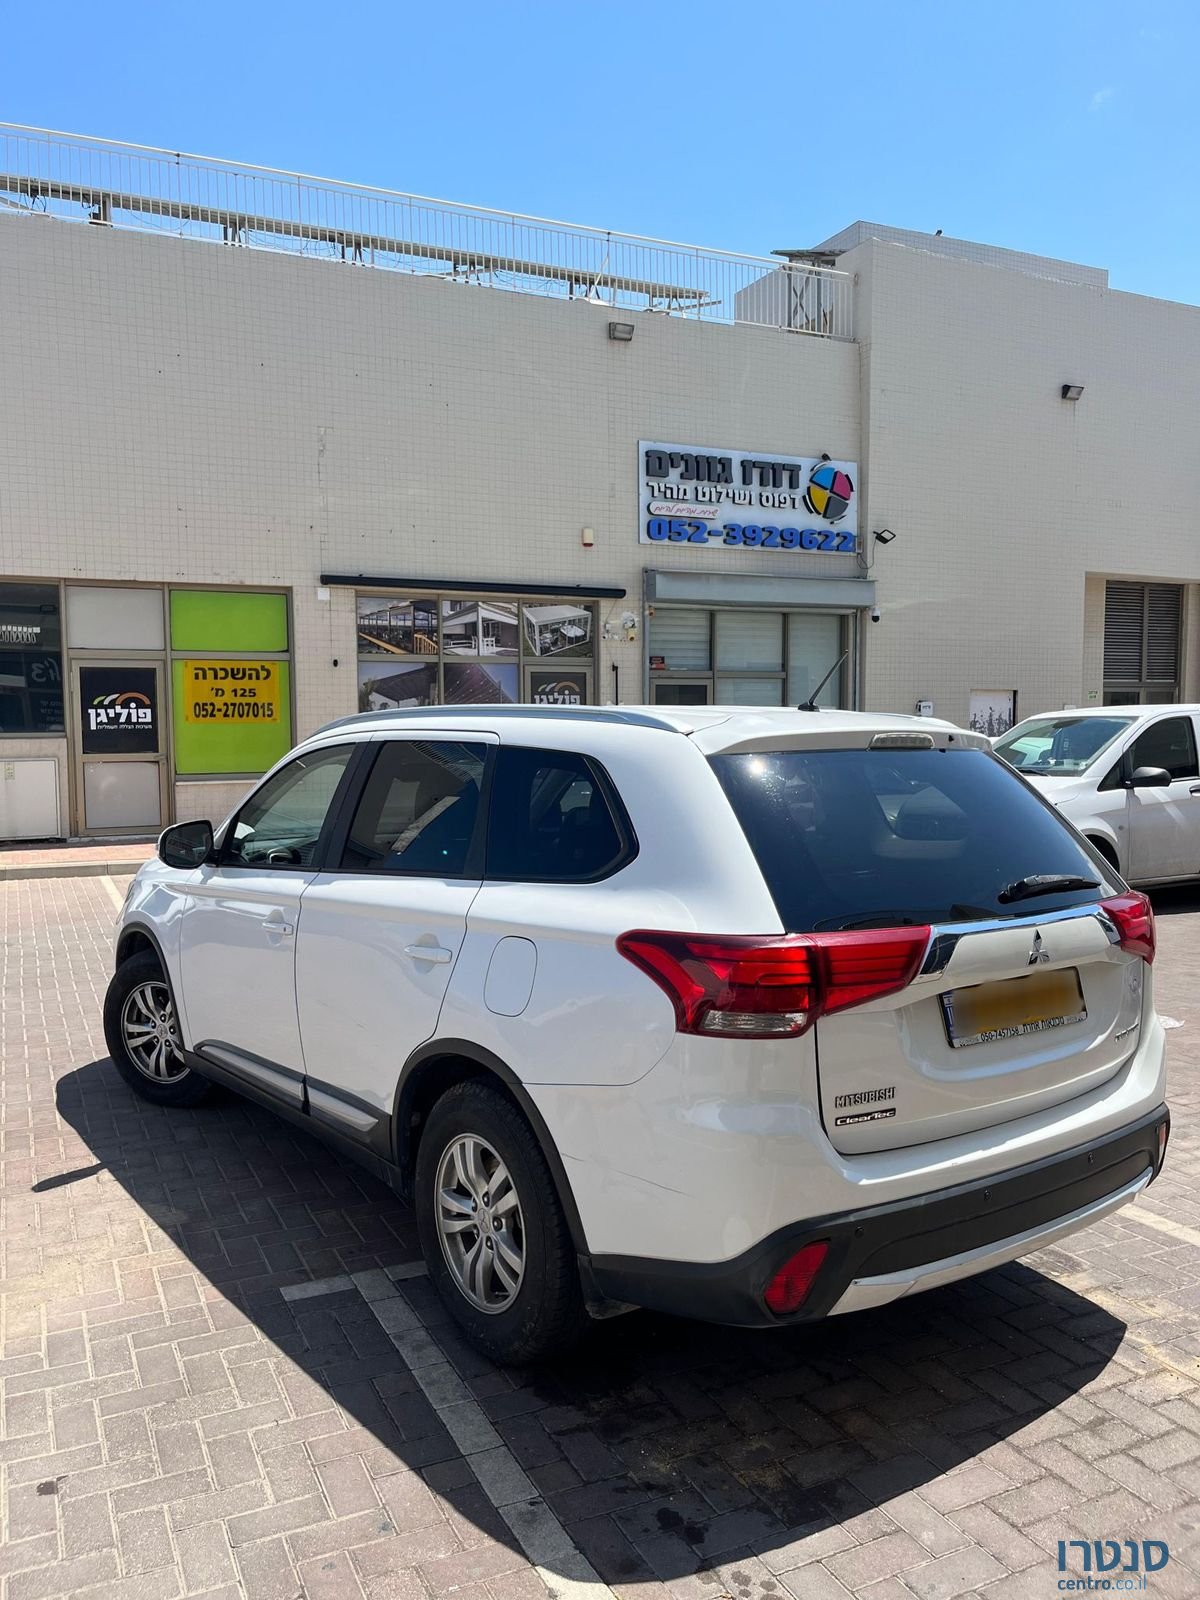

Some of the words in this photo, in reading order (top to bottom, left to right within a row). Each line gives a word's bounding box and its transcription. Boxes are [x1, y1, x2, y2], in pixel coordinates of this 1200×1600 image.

[645, 450, 733, 484] גוונים
[741, 459, 801, 489] דודו
[647, 481, 691, 500] מהיר
[695, 485, 754, 506] ושילוט
[759, 491, 800, 509] דפוס
[647, 518, 856, 552] 052-3929622
[194, 665, 271, 680] להשכרה
[231, 688, 256, 698] 125
[88, 704, 151, 730] פוליגן
[194, 702, 274, 718] 052-2707015
[835, 1087, 896, 1108] MITSUBISHI
[836, 1110, 895, 1125] ClearTec
